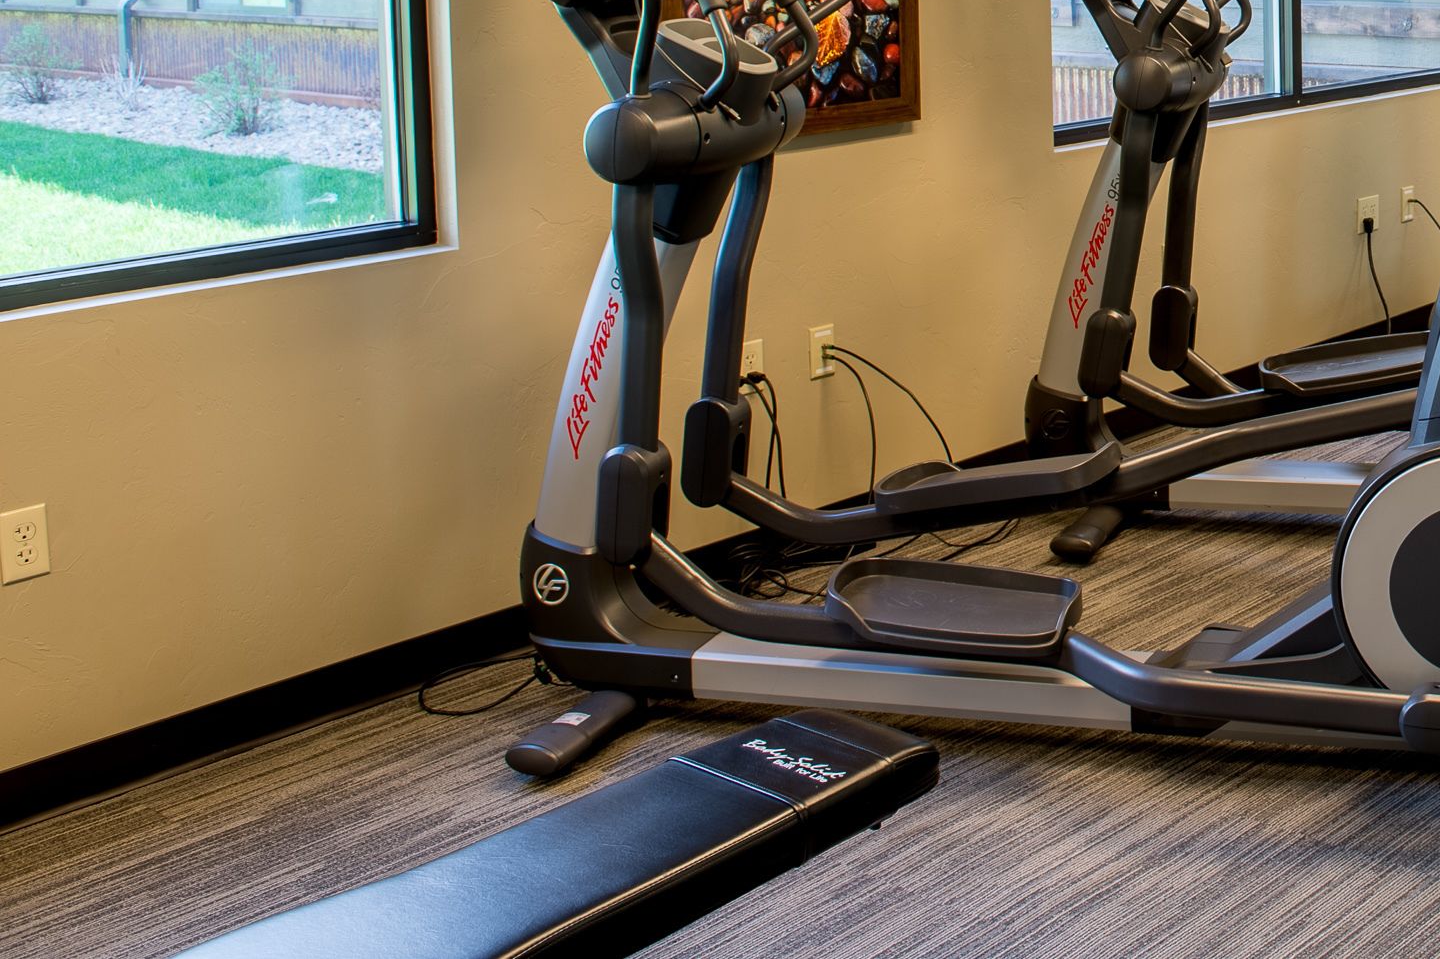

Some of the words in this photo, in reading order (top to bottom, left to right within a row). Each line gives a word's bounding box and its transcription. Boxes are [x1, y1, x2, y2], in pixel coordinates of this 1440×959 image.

[742, 738, 846, 779] Body-Solid
[772, 758, 796, 770] Built
[796, 767, 811, 776] for
[809, 773, 828, 783] Life
